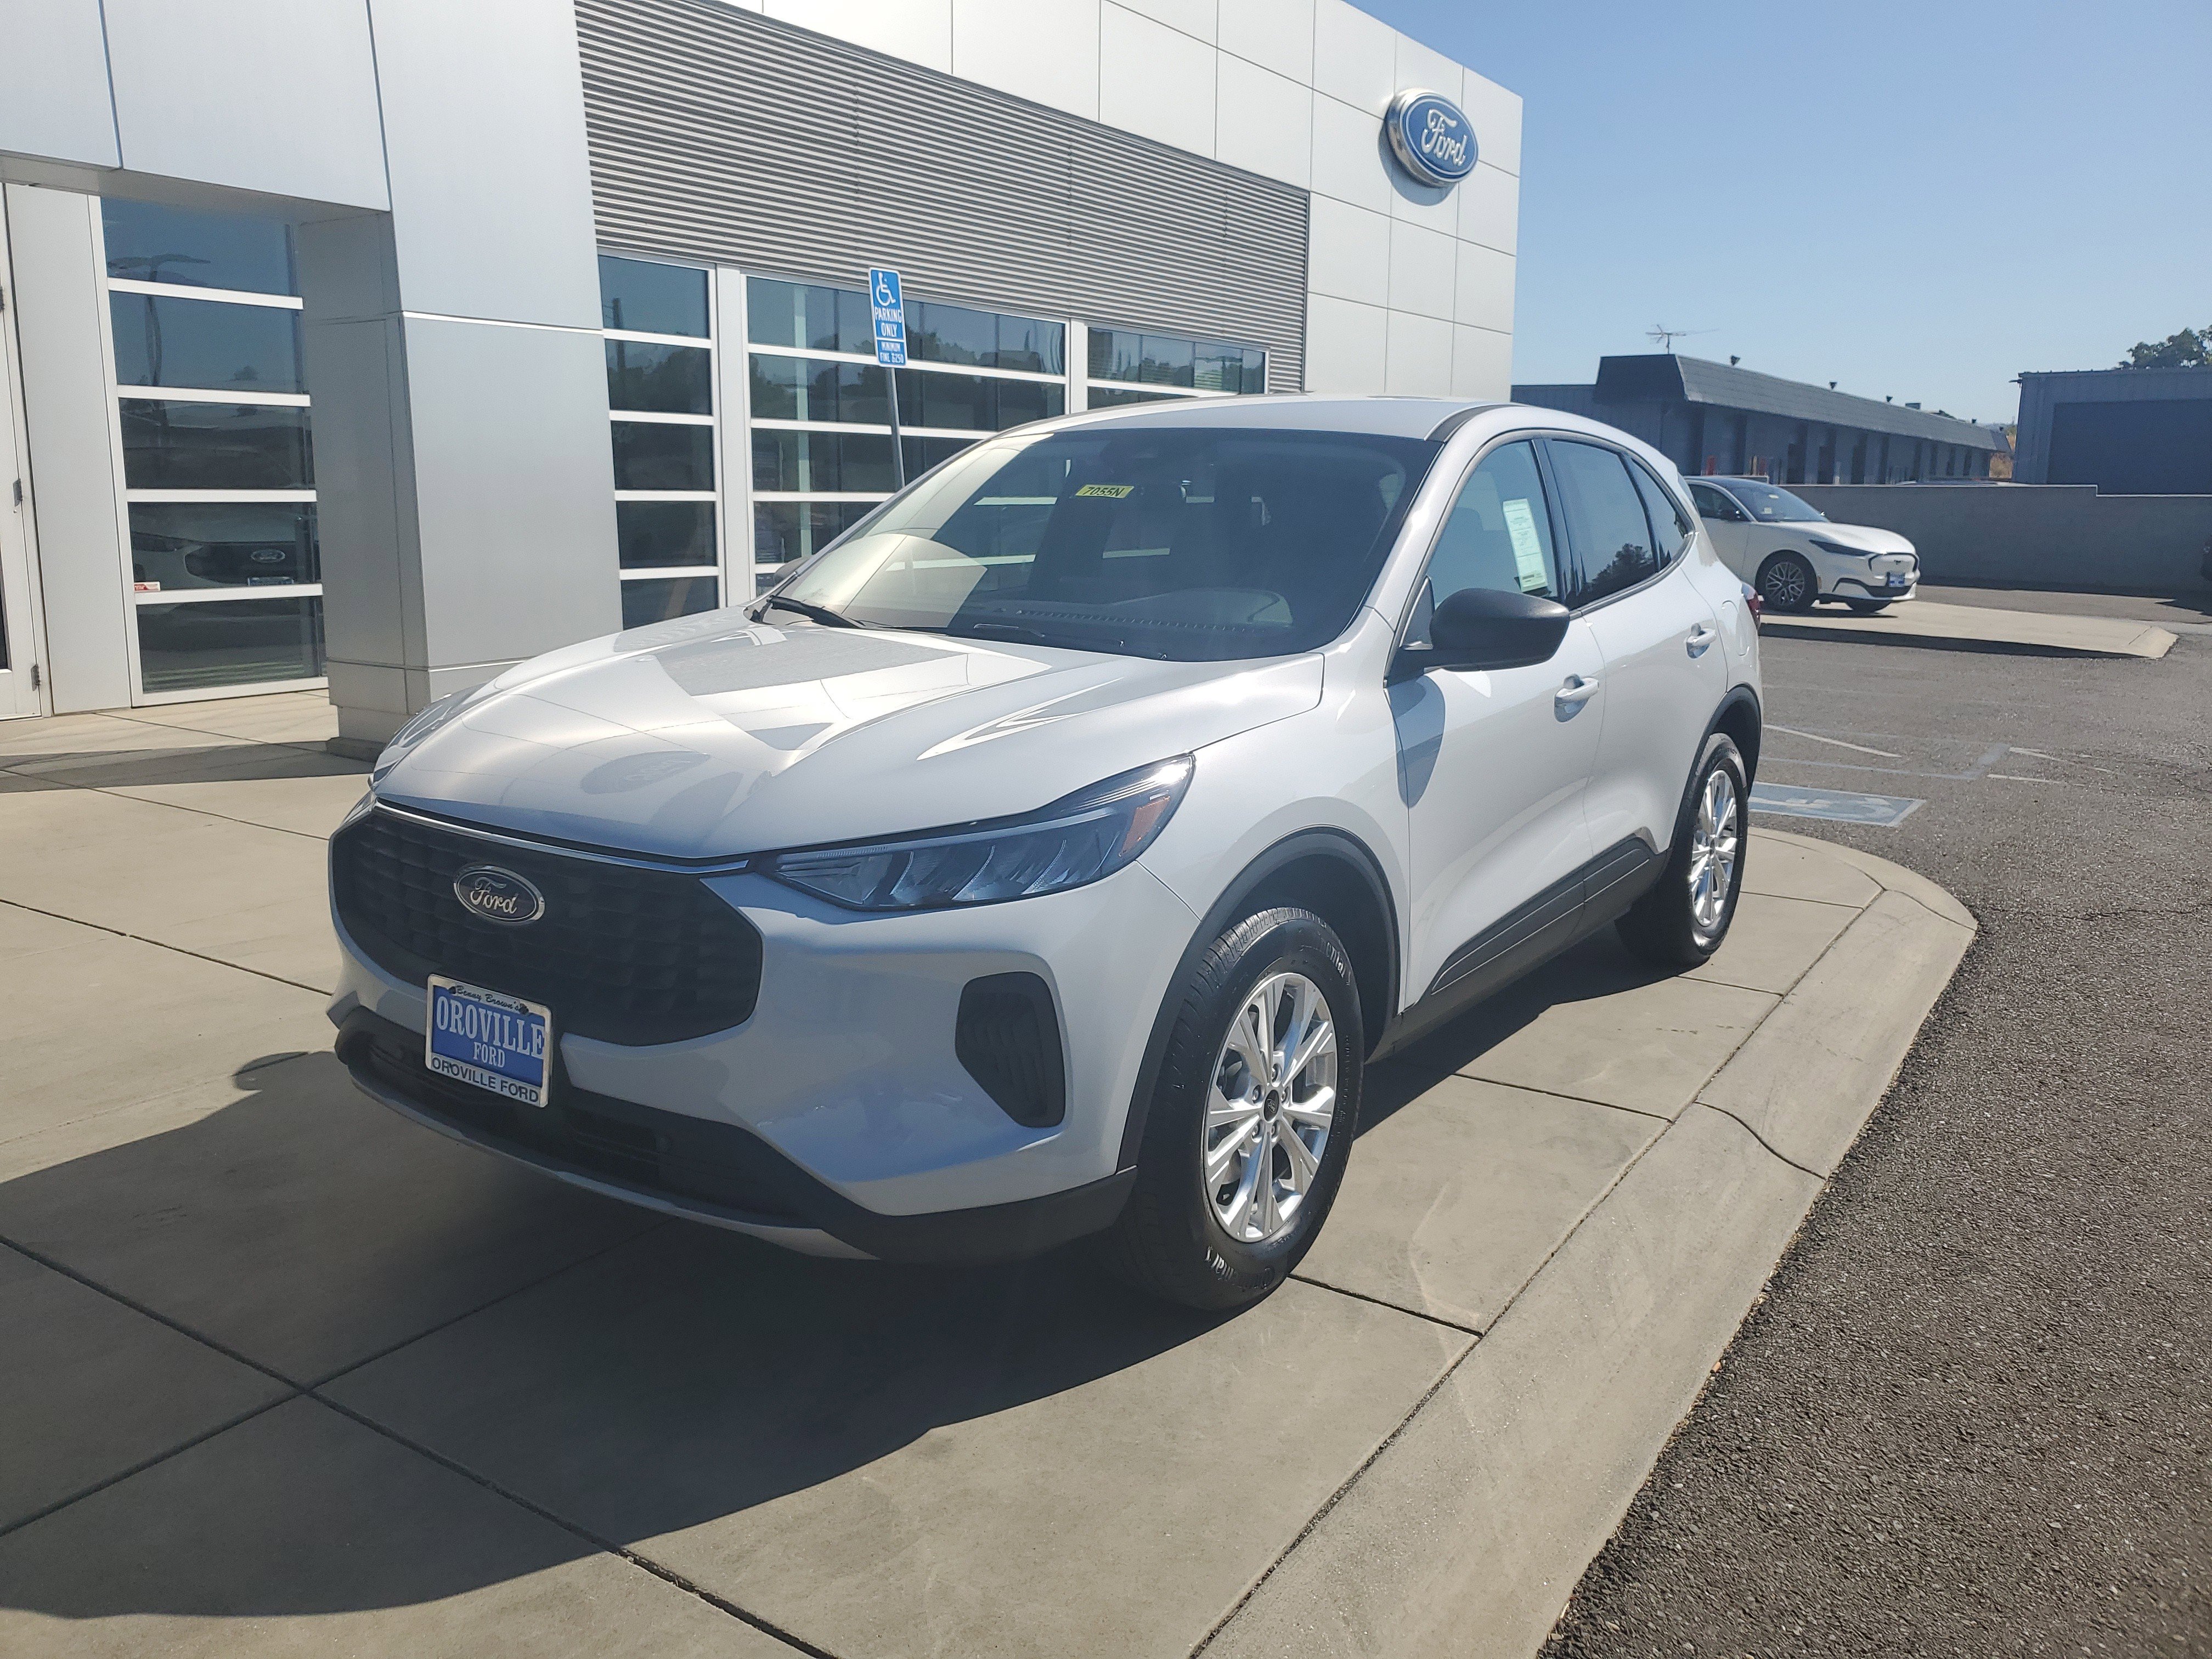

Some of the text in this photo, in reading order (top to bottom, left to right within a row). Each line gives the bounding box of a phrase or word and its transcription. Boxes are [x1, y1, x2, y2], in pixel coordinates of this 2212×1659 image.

[1421, 109, 1468, 166] Ford
[874, 307, 902, 323] PARKING
[881, 323, 898, 337] ONLY
[1082, 487, 1125, 497] 7055N
[470, 877, 519, 914] Ford
[436, 996, 545, 1059] OROVILLE
[473, 1041, 506, 1068] FORD
[431, 1057, 539, 1103] OROVILLE FORD
